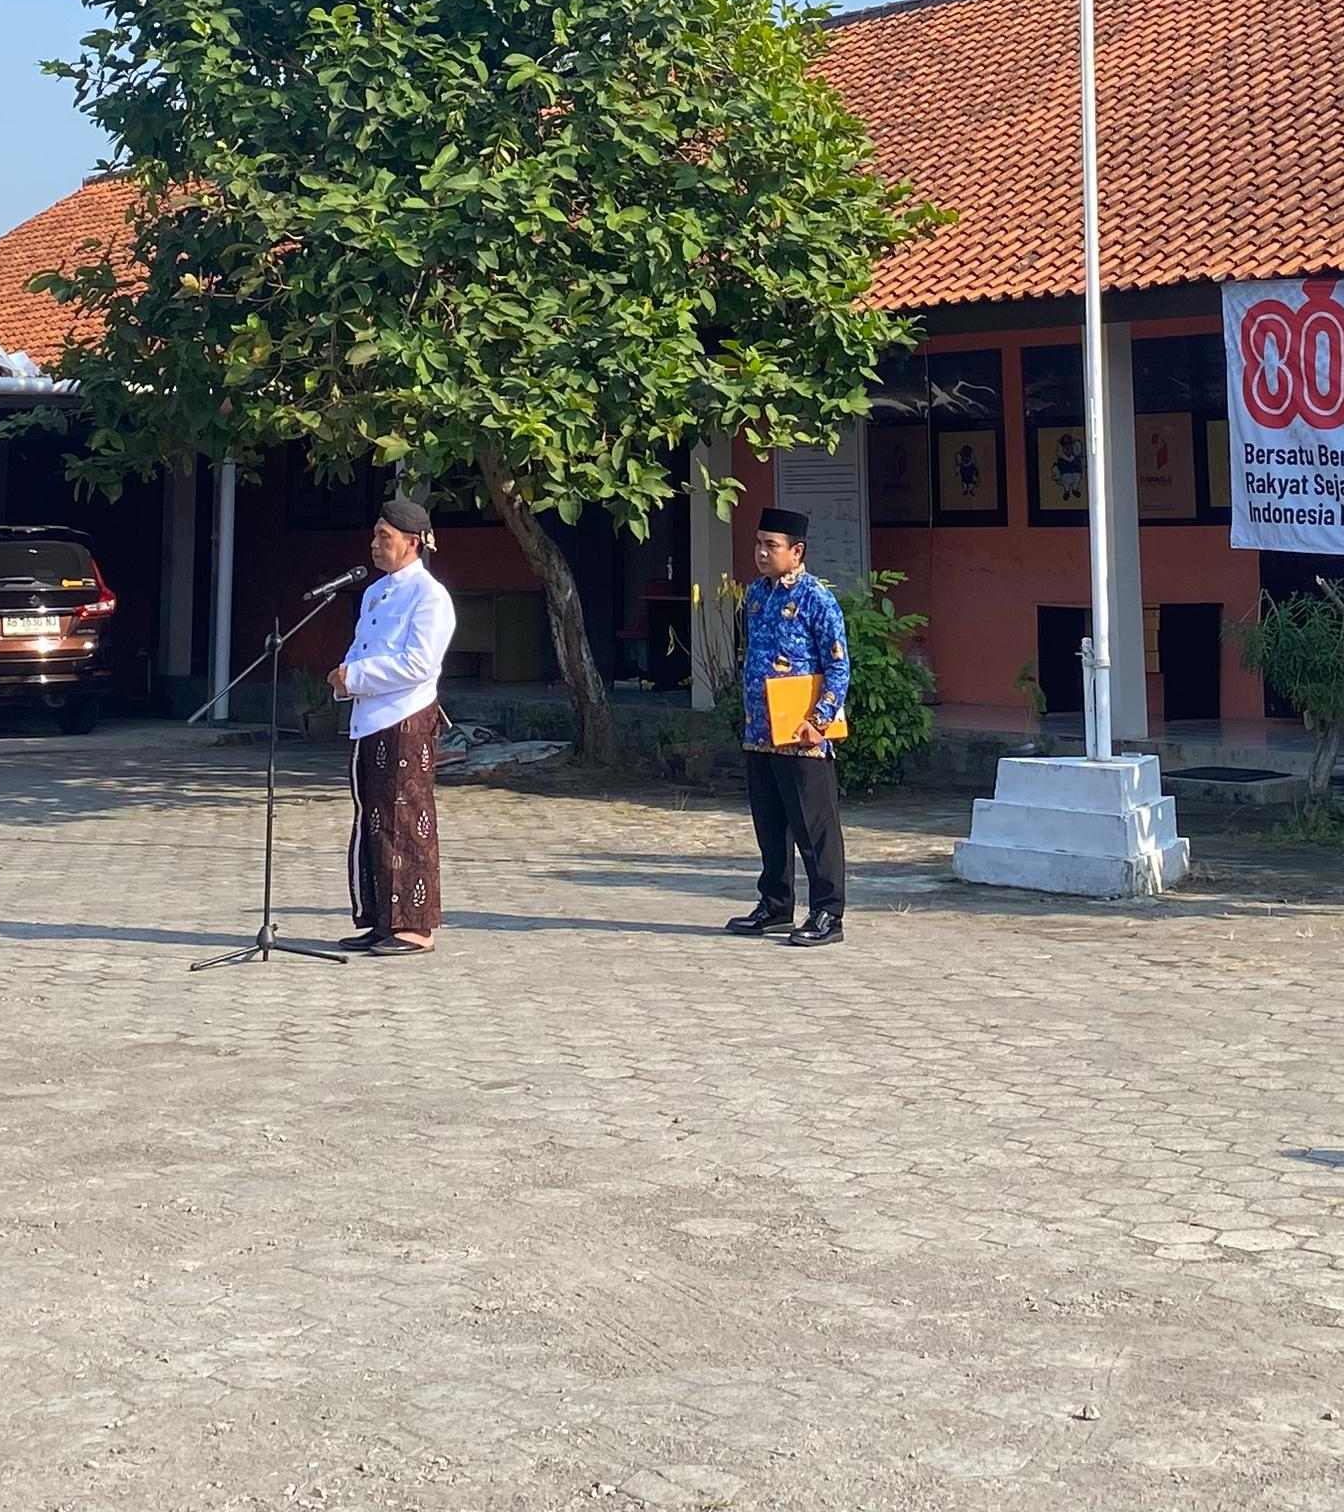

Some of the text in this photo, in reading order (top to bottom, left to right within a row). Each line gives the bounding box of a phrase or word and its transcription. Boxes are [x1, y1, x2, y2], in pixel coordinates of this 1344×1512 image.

[1244, 443, 1314, 466] Bersatu
[1245, 472, 1309, 499] Rakyat
[1249, 501, 1335, 526] Indonesia
